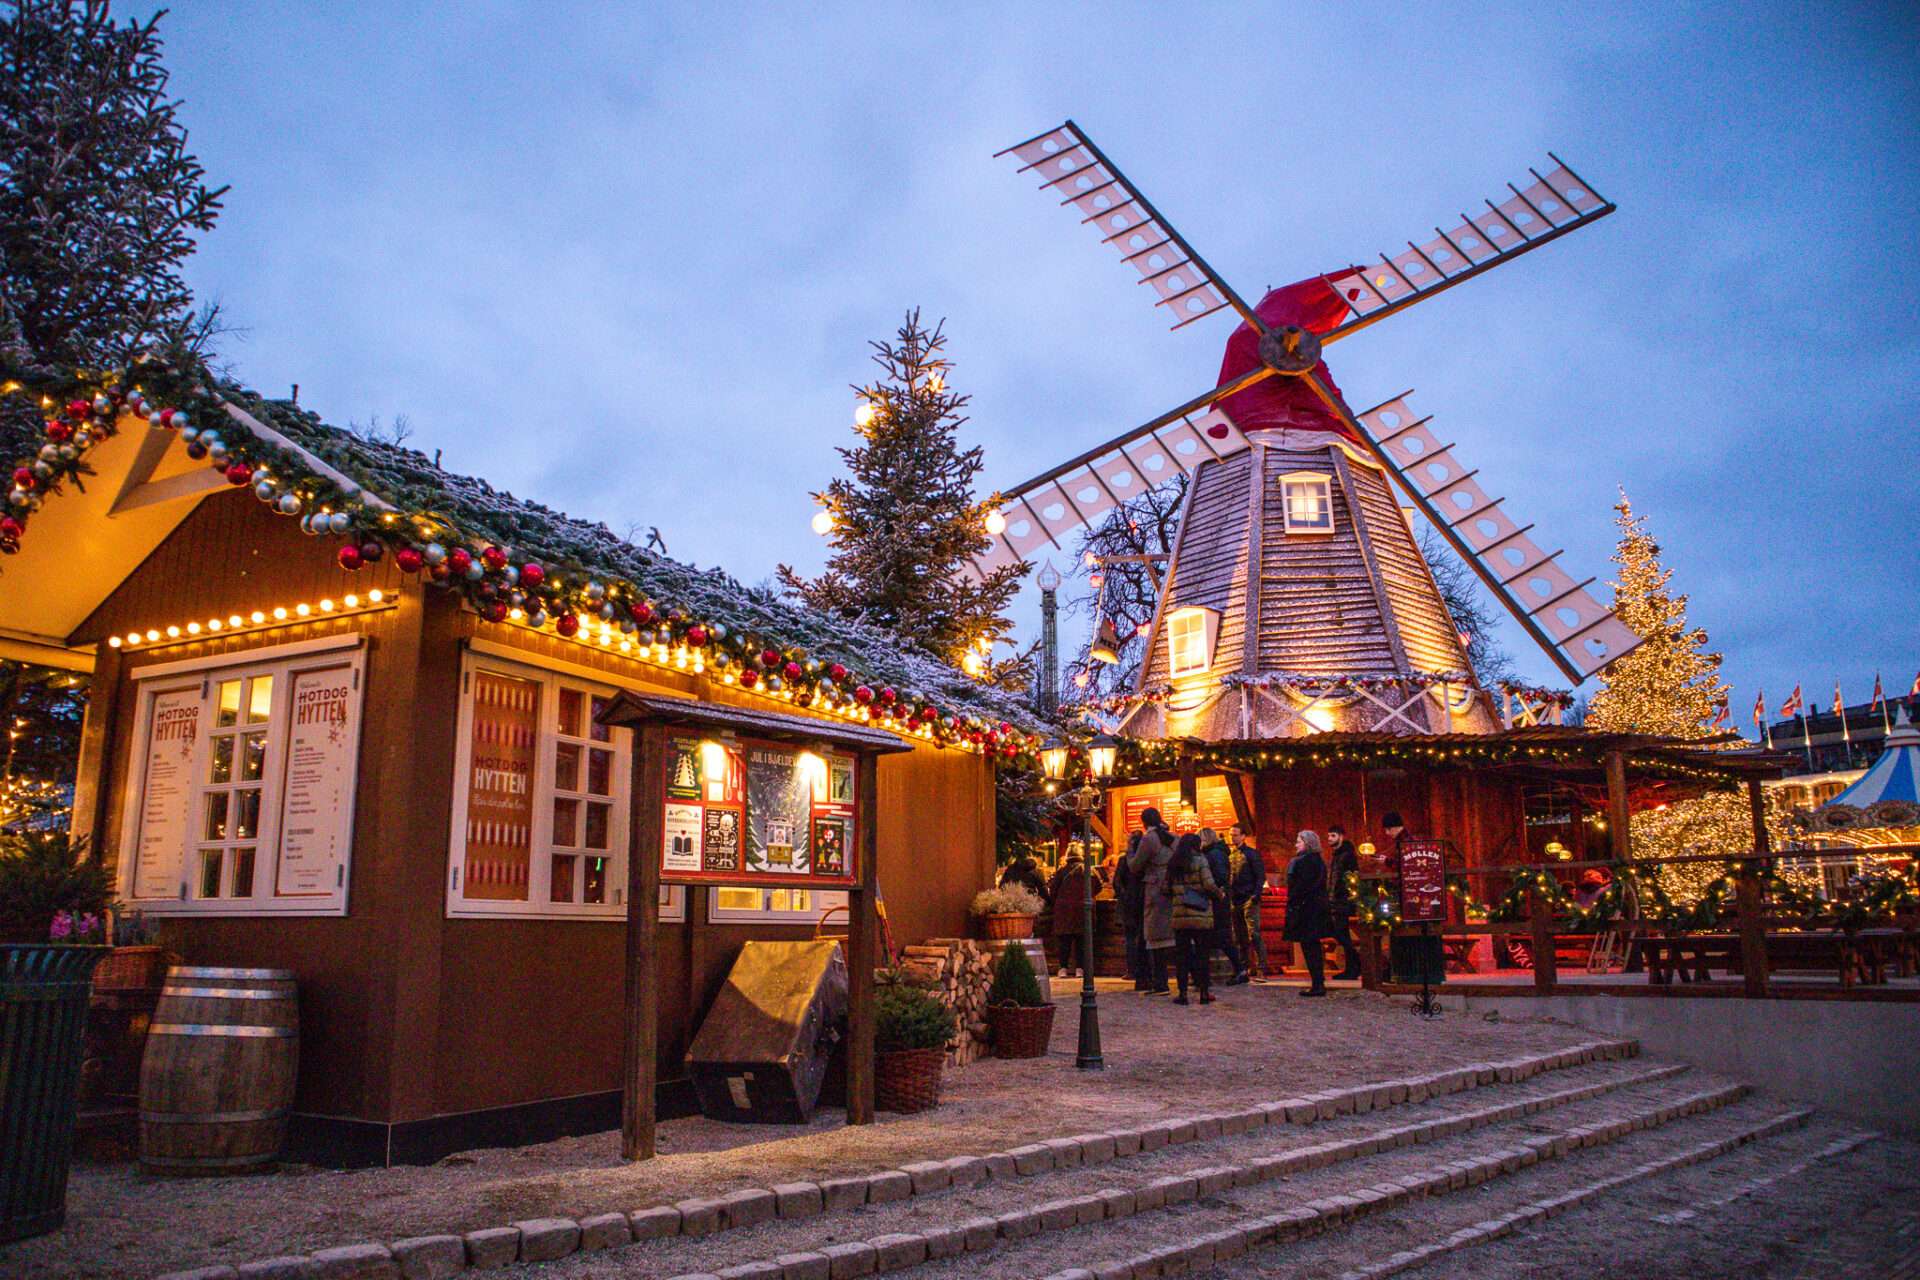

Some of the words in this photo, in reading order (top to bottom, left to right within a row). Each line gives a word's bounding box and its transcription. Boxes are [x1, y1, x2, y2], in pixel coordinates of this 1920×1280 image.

[298, 686, 348, 703] HOTDOG
[158, 706, 199, 720] HOTDOG
[297, 701, 347, 725] HYTTEN
[156, 719, 197, 741] HYTTEN
[475, 756, 528, 772] HOTDOG
[474, 767, 526, 795] HYTTEN
[1403, 850, 1440, 861] MØLLEN
